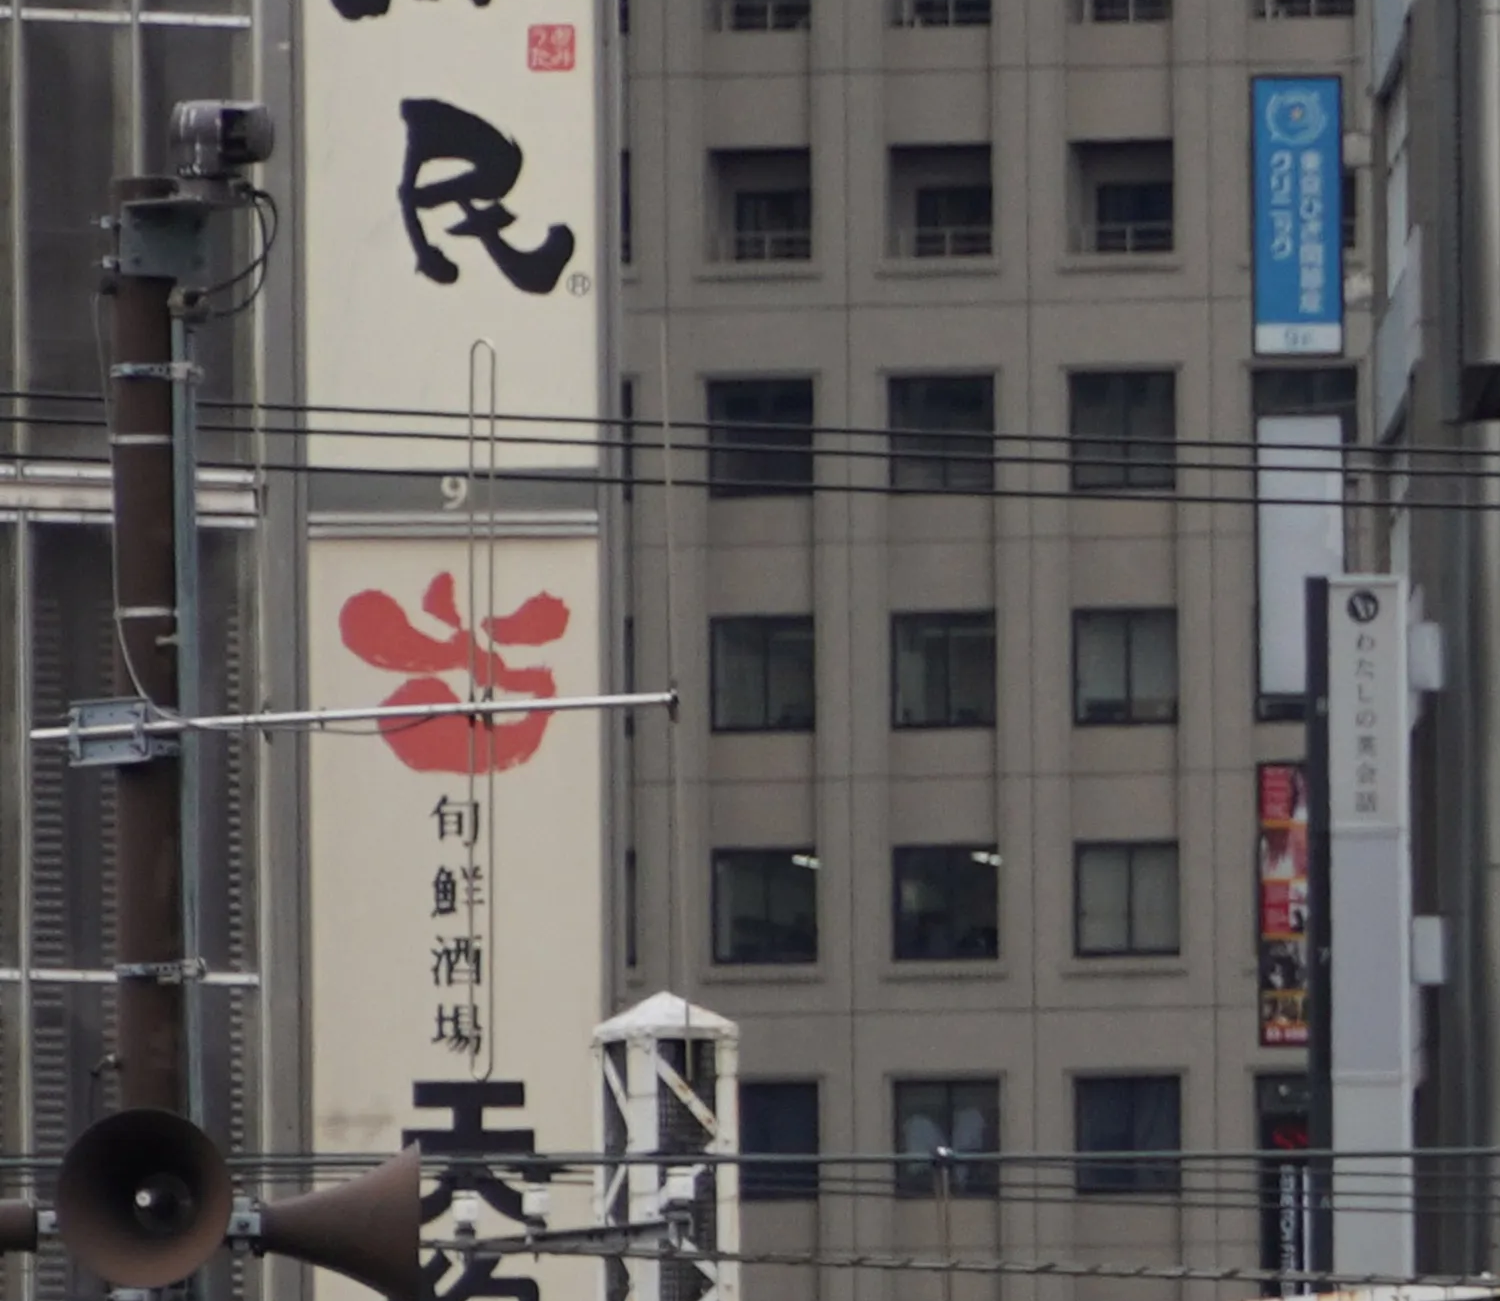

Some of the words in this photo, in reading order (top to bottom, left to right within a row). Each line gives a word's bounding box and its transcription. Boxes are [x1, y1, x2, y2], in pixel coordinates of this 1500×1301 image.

[439, 475, 468, 510] 9
[429, 794, 486, 1055] 旬鮮酒場
